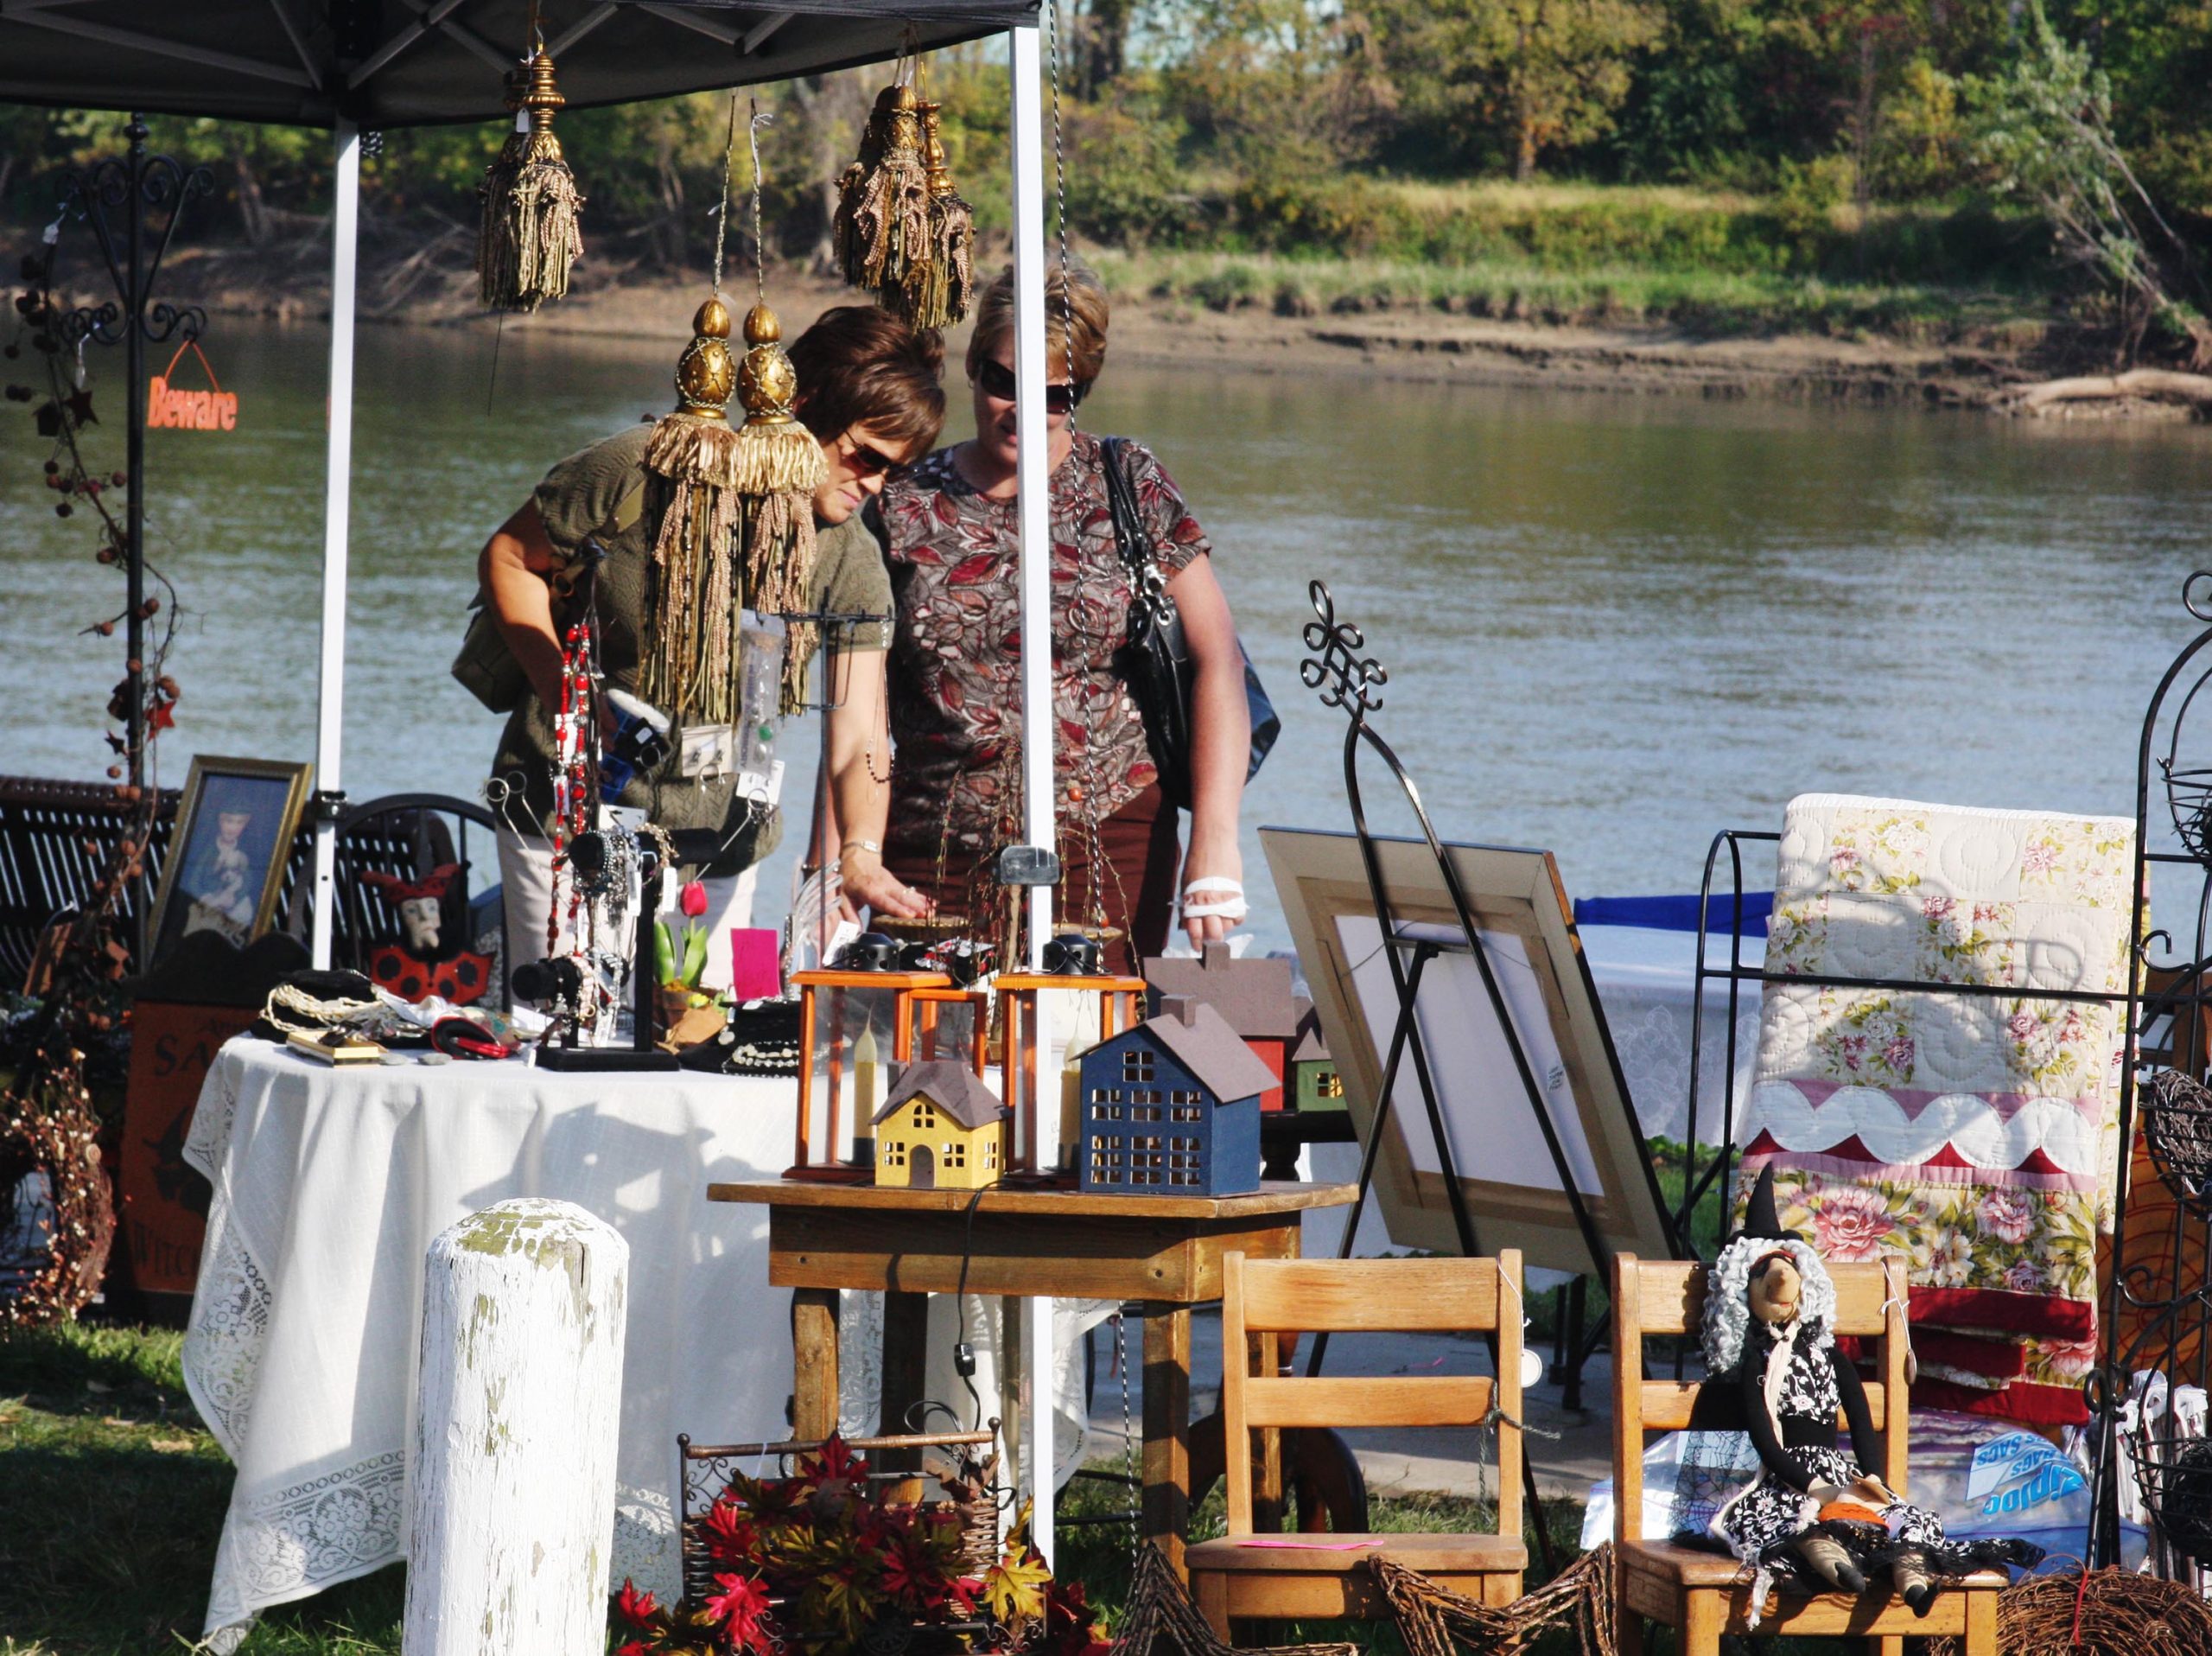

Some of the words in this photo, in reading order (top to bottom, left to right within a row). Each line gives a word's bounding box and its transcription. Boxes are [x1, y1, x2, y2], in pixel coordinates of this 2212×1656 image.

[147, 376, 238, 431] Beware
[1976, 1435, 2023, 1467] SACS
[1982, 1461, 2083, 1515] Ziploc
